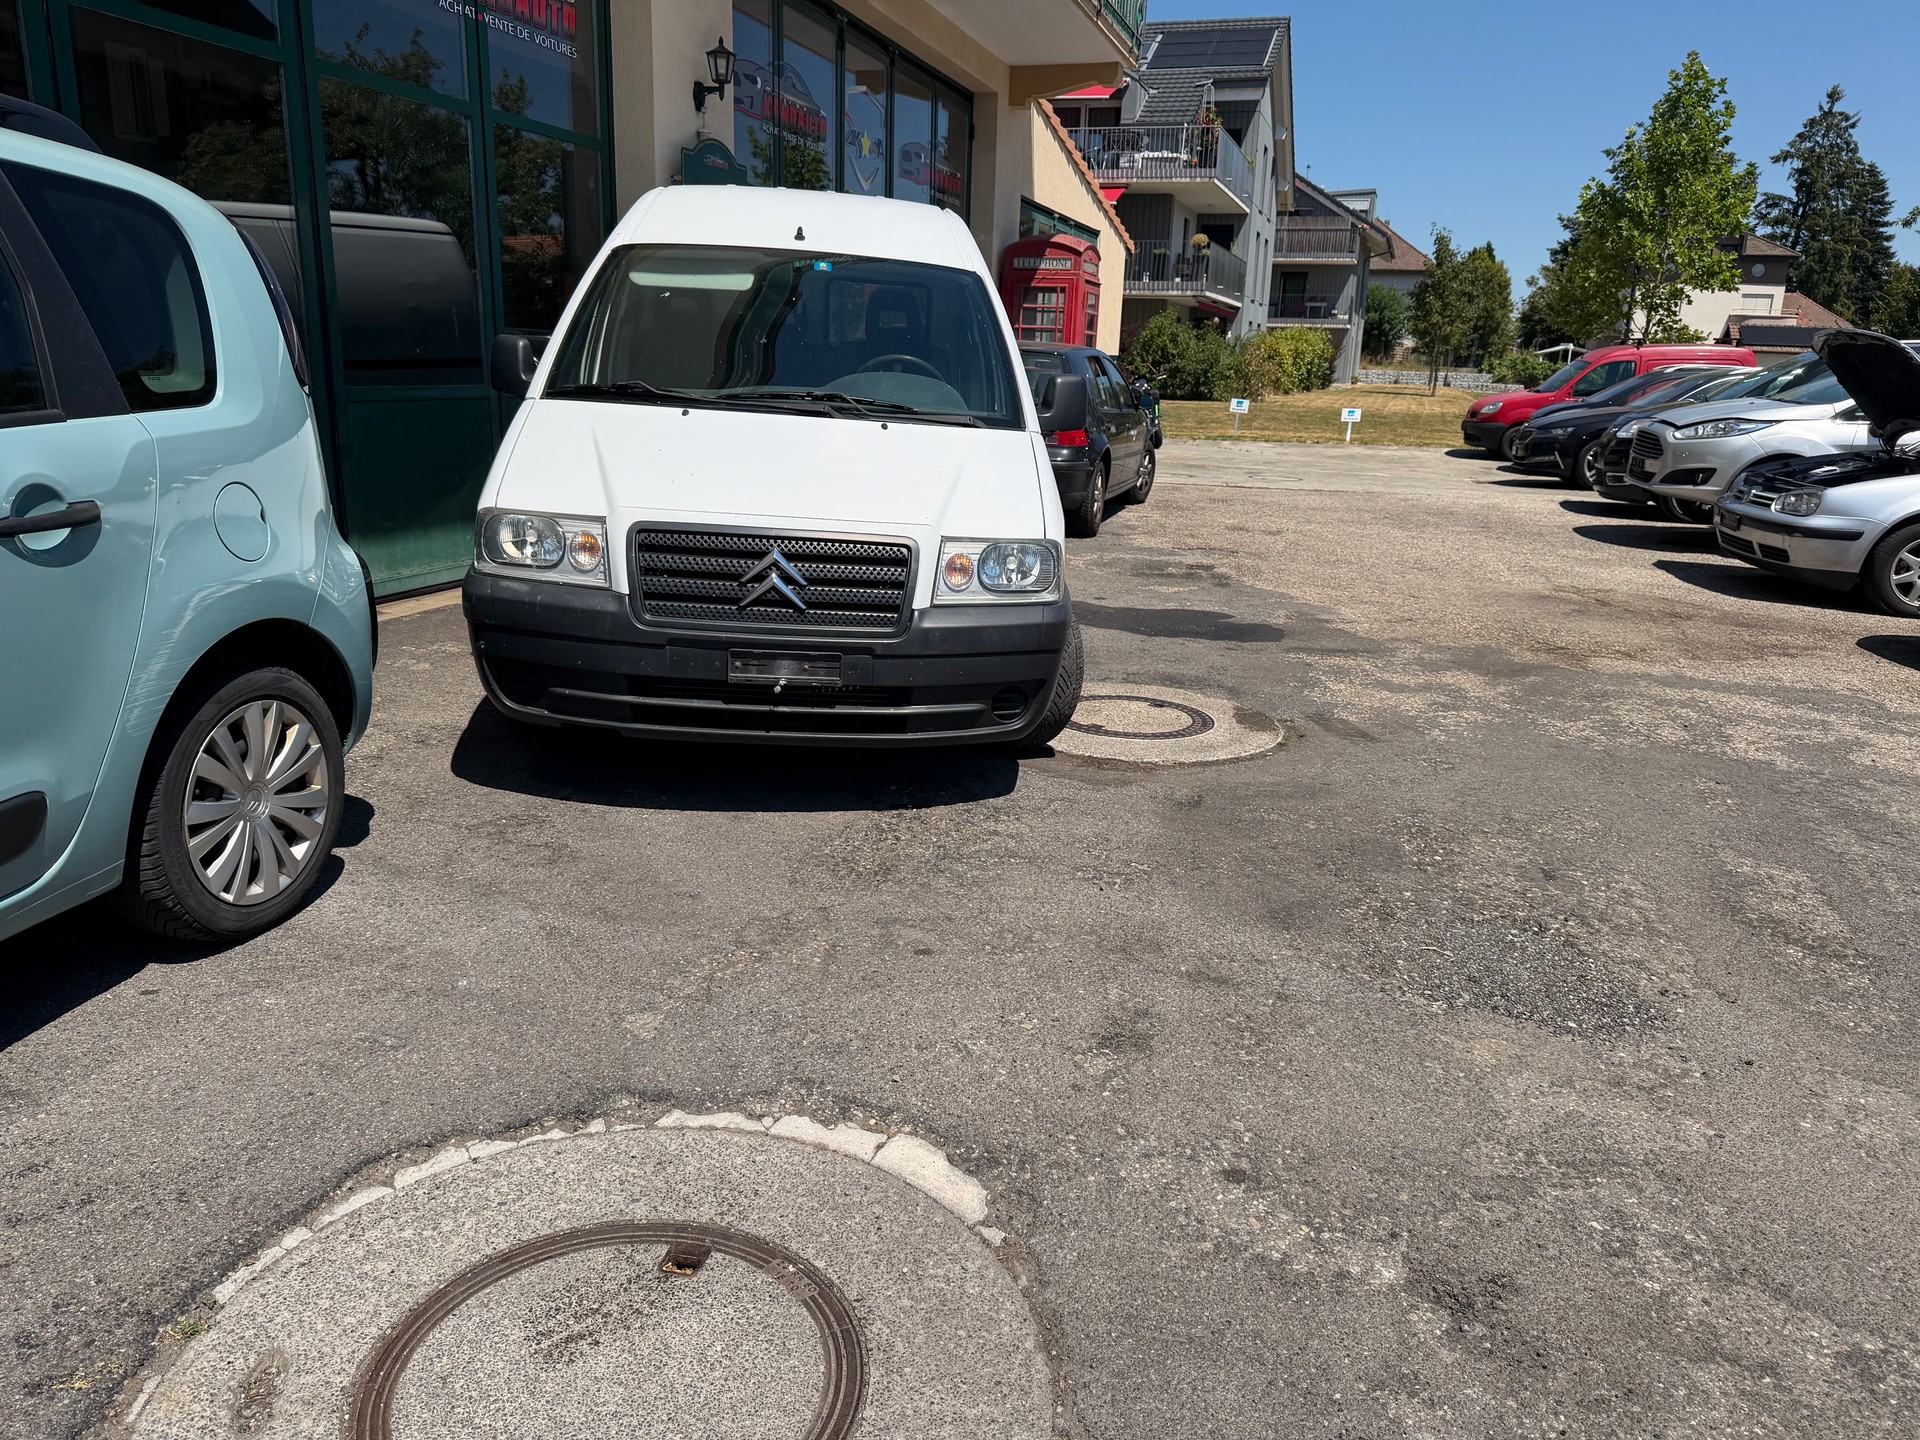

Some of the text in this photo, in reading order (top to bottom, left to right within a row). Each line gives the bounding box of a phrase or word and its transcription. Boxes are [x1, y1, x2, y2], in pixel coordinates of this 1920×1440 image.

[439, 0, 577, 58] ACHAT VENTE DE VOITURES
[1016, 258, 1070, 268] TELEPHONE
